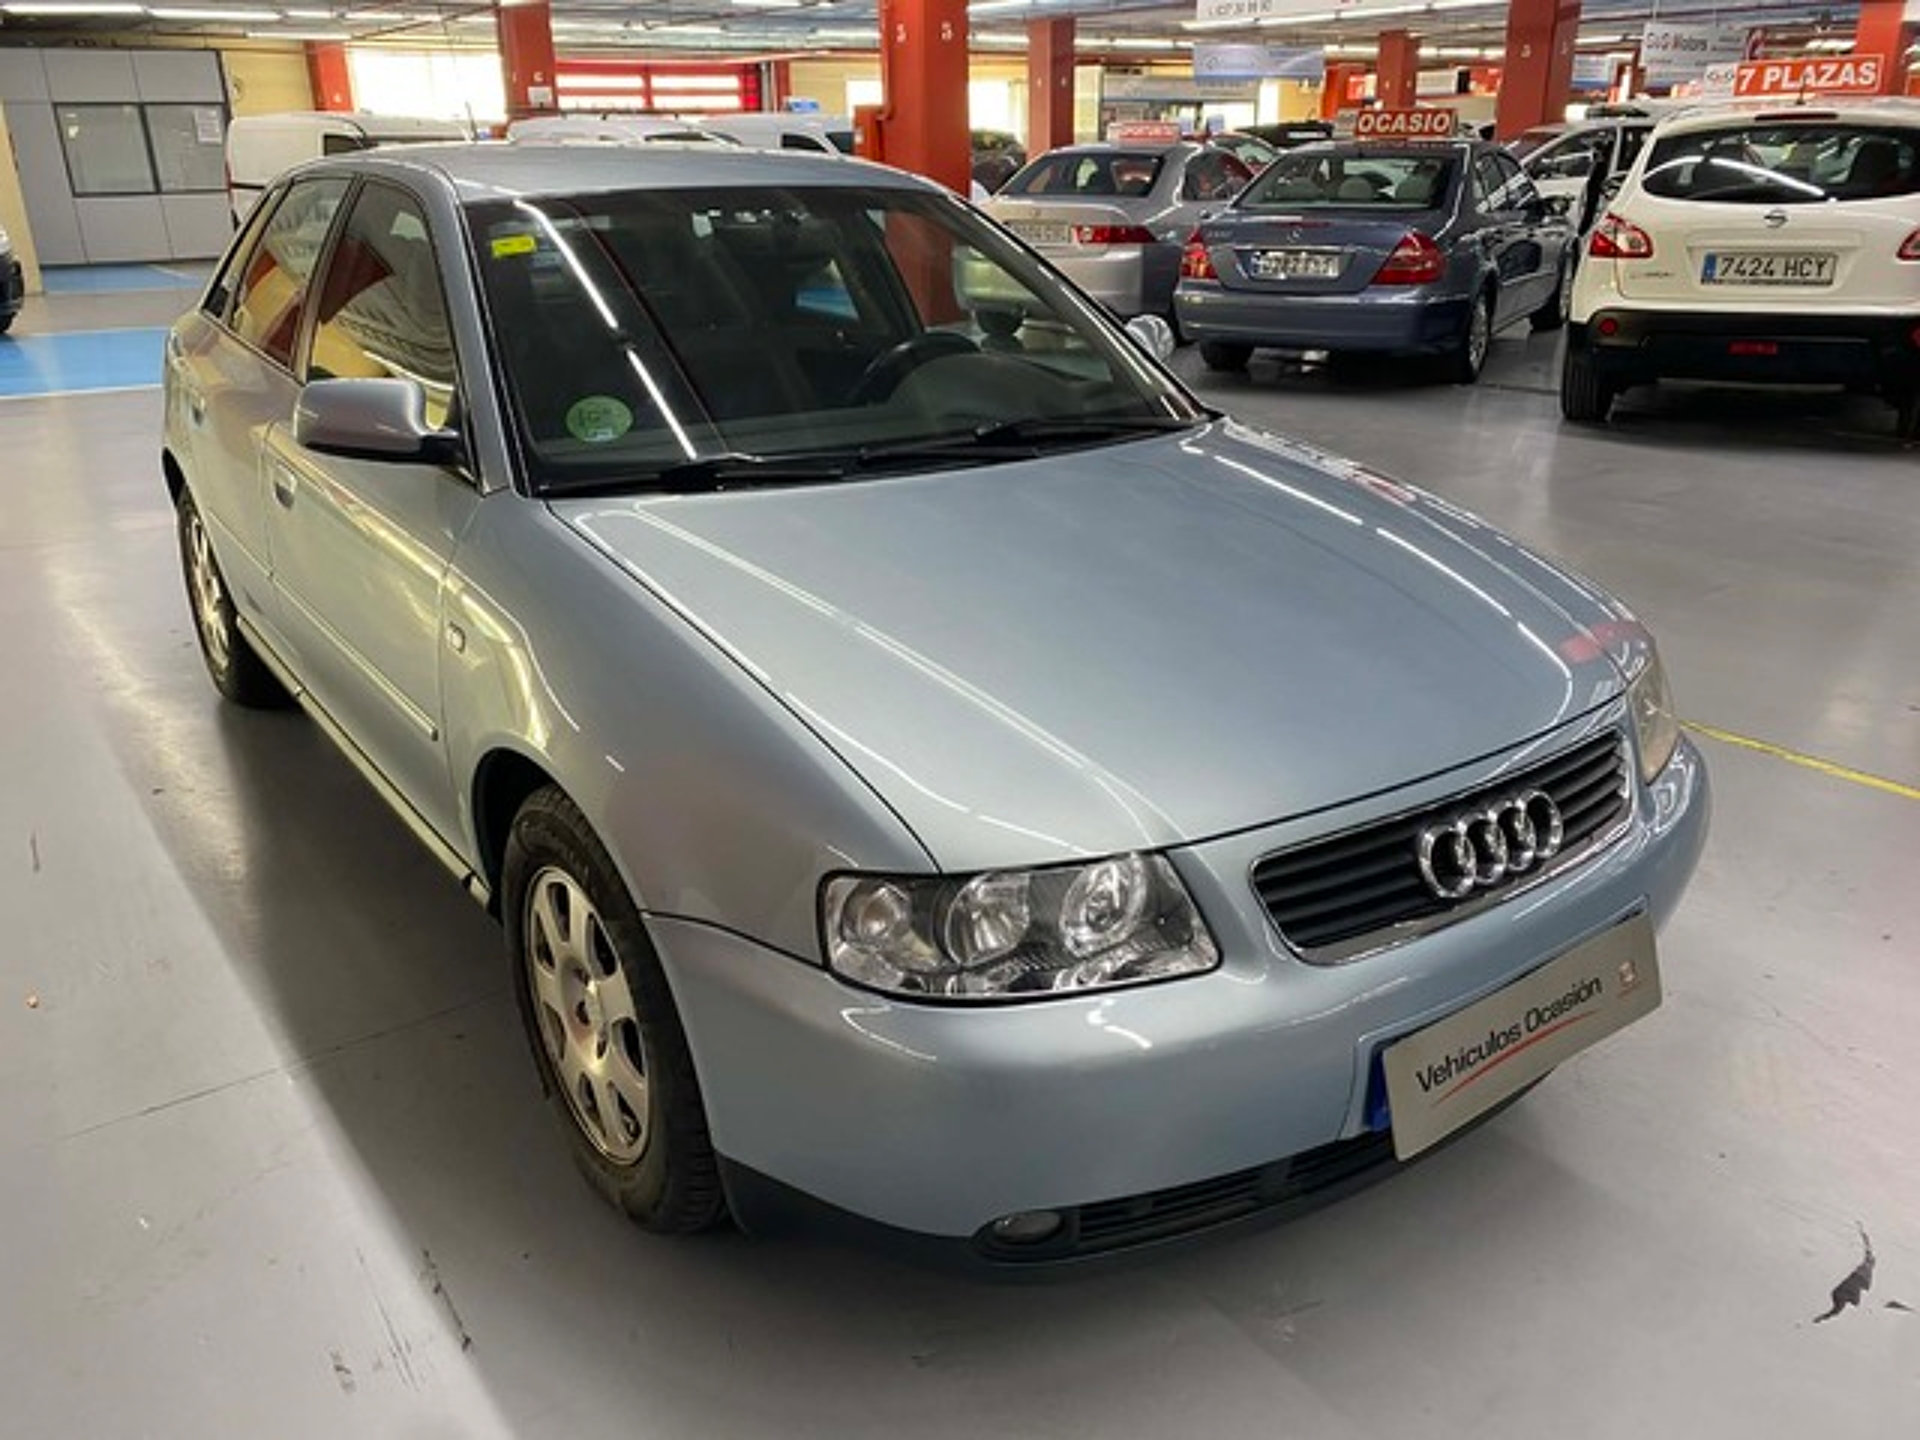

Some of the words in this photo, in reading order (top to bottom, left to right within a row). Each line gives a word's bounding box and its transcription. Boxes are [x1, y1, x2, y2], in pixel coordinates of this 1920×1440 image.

[1739, 68, 1756, 92] 7
[1762, 62, 1877, 91] PLAZAS
[1358, 112, 1451, 133] OCASIO
[1719, 257, 1775, 277] 7424
[1783, 257, 1828, 277] HCY
[1524, 977, 1603, 1033] Ocasión
